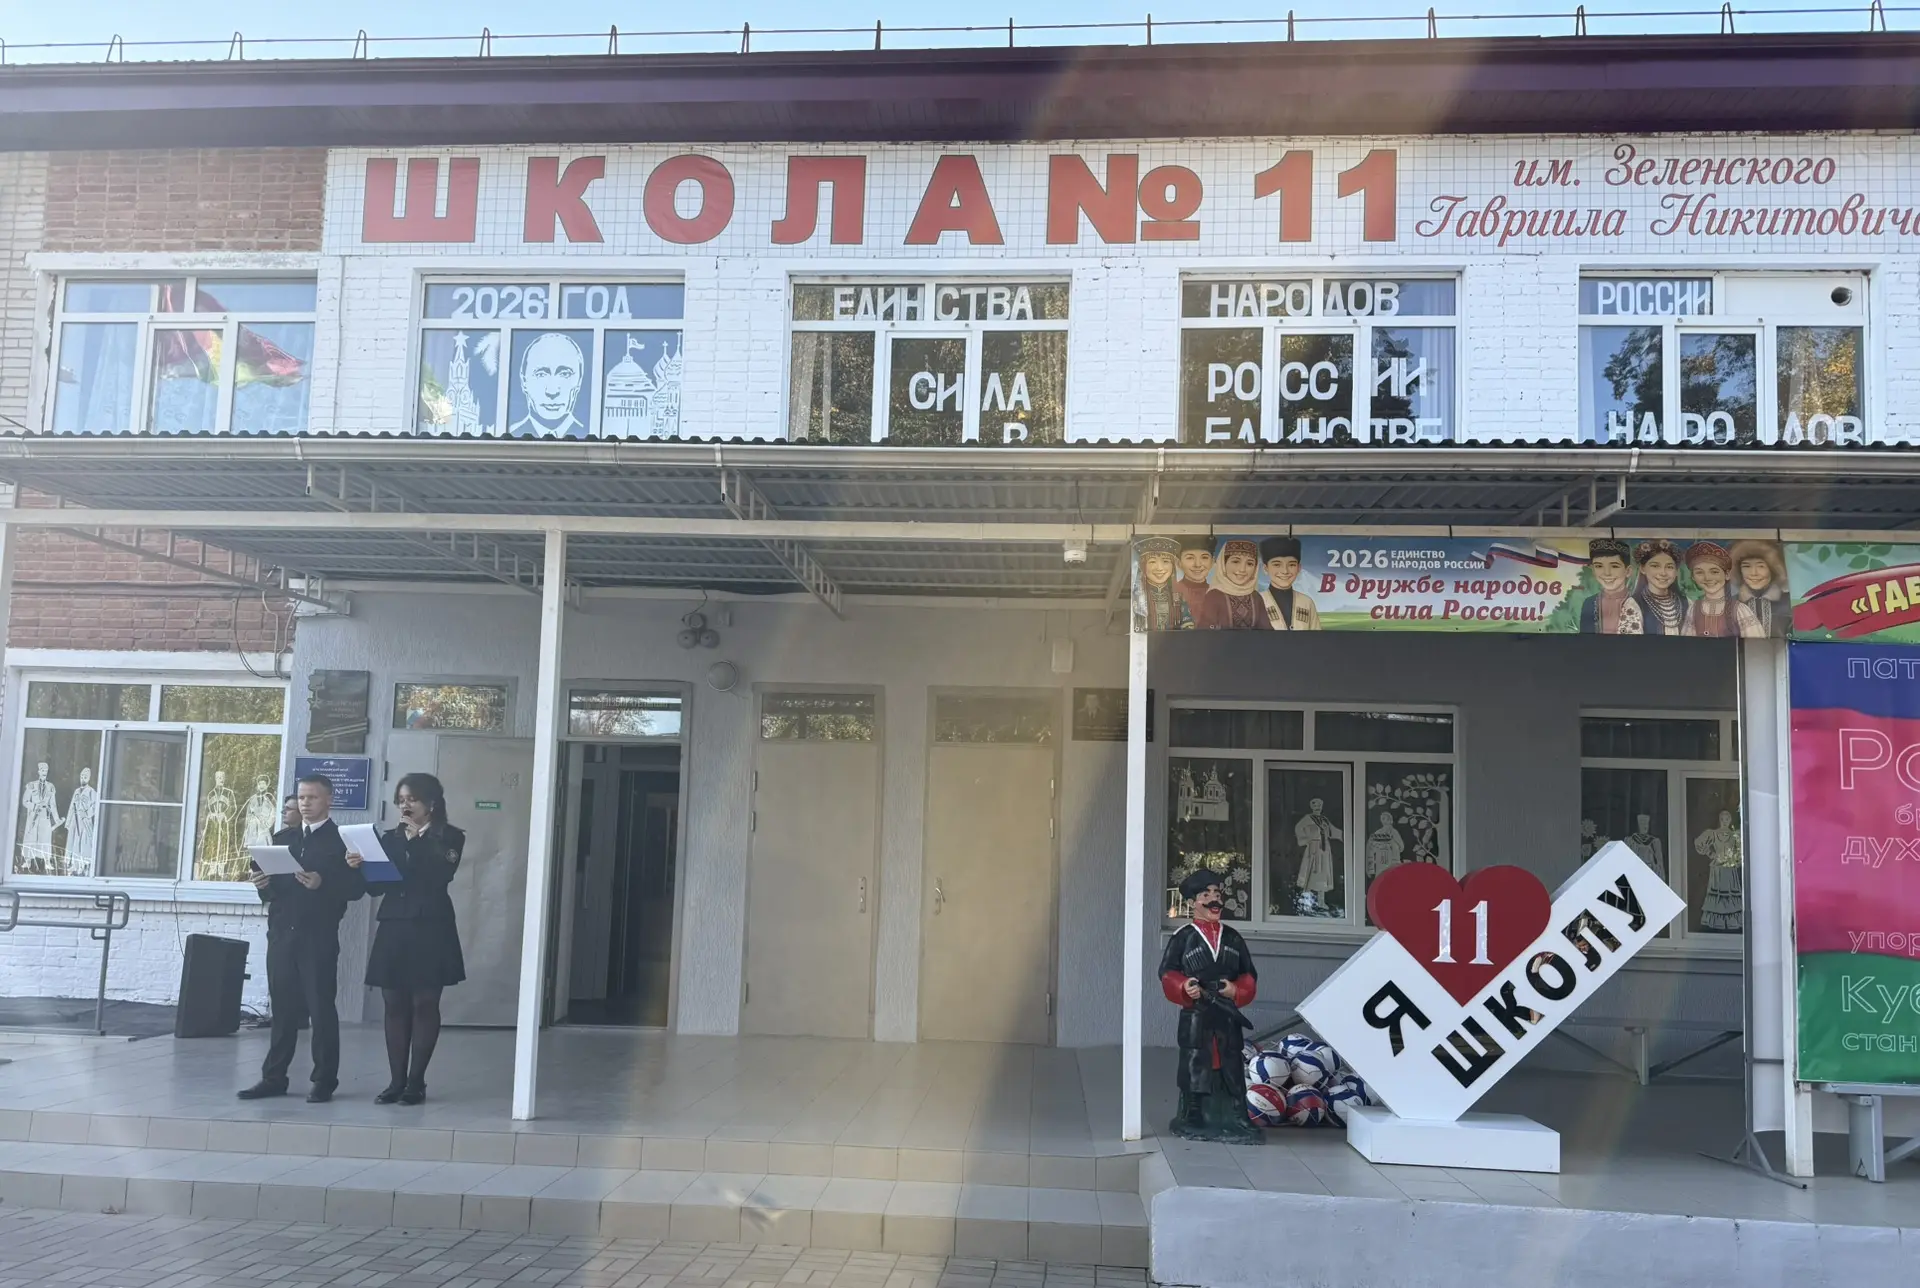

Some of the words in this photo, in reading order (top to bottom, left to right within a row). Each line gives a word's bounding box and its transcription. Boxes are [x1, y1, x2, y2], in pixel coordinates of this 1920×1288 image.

[1513, 157, 1581, 188] им.
[1604, 143, 1836, 187] Зеленского
[361, 153, 1005, 246] ШКОЛА
[1046, 151, 1203, 246] №
[1253, 149, 1398, 243] 11
[1414, 193, 1627, 248] Гавриила
[451, 285, 547, 320] 2026
[562, 285, 633, 320] ГОД
[833, 286, 1034, 321] ЕДИНСТВА
[1210, 281, 1401, 318] НАРОДОВ
[1598, 281, 1711, 316] РОССИИ
[908, 370, 1032, 413] СИЛА
[1207, 356, 1428, 403] РОССИИ
[1608, 410, 1864, 446] НАРОДОВ
[1327, 549, 1389, 568] 2026
[1391, 550, 1446, 560] ЕДИНСТВО
[1391, 560, 1441, 570] НАРОДОВ
[1444, 560, 1485, 570] РОССИИ
[1319, 573, 1336, 593] В
[1345, 573, 1445, 600] дружбе
[1453, 574, 1562, 601] народов
[1851, 575, 1920, 614] «ГДЕ
[1370, 602, 1433, 621] сила
[1440, 599, 1546, 622] России!
[1847, 657, 1920, 680] пат
[1895, 803, 1920, 831] б
[1841, 836, 1920, 868] дух
[1431, 898, 1495, 965] 11
[1430, 873, 1647, 1089] ШКОЛУ
[1362, 979, 1432, 1057] Я
